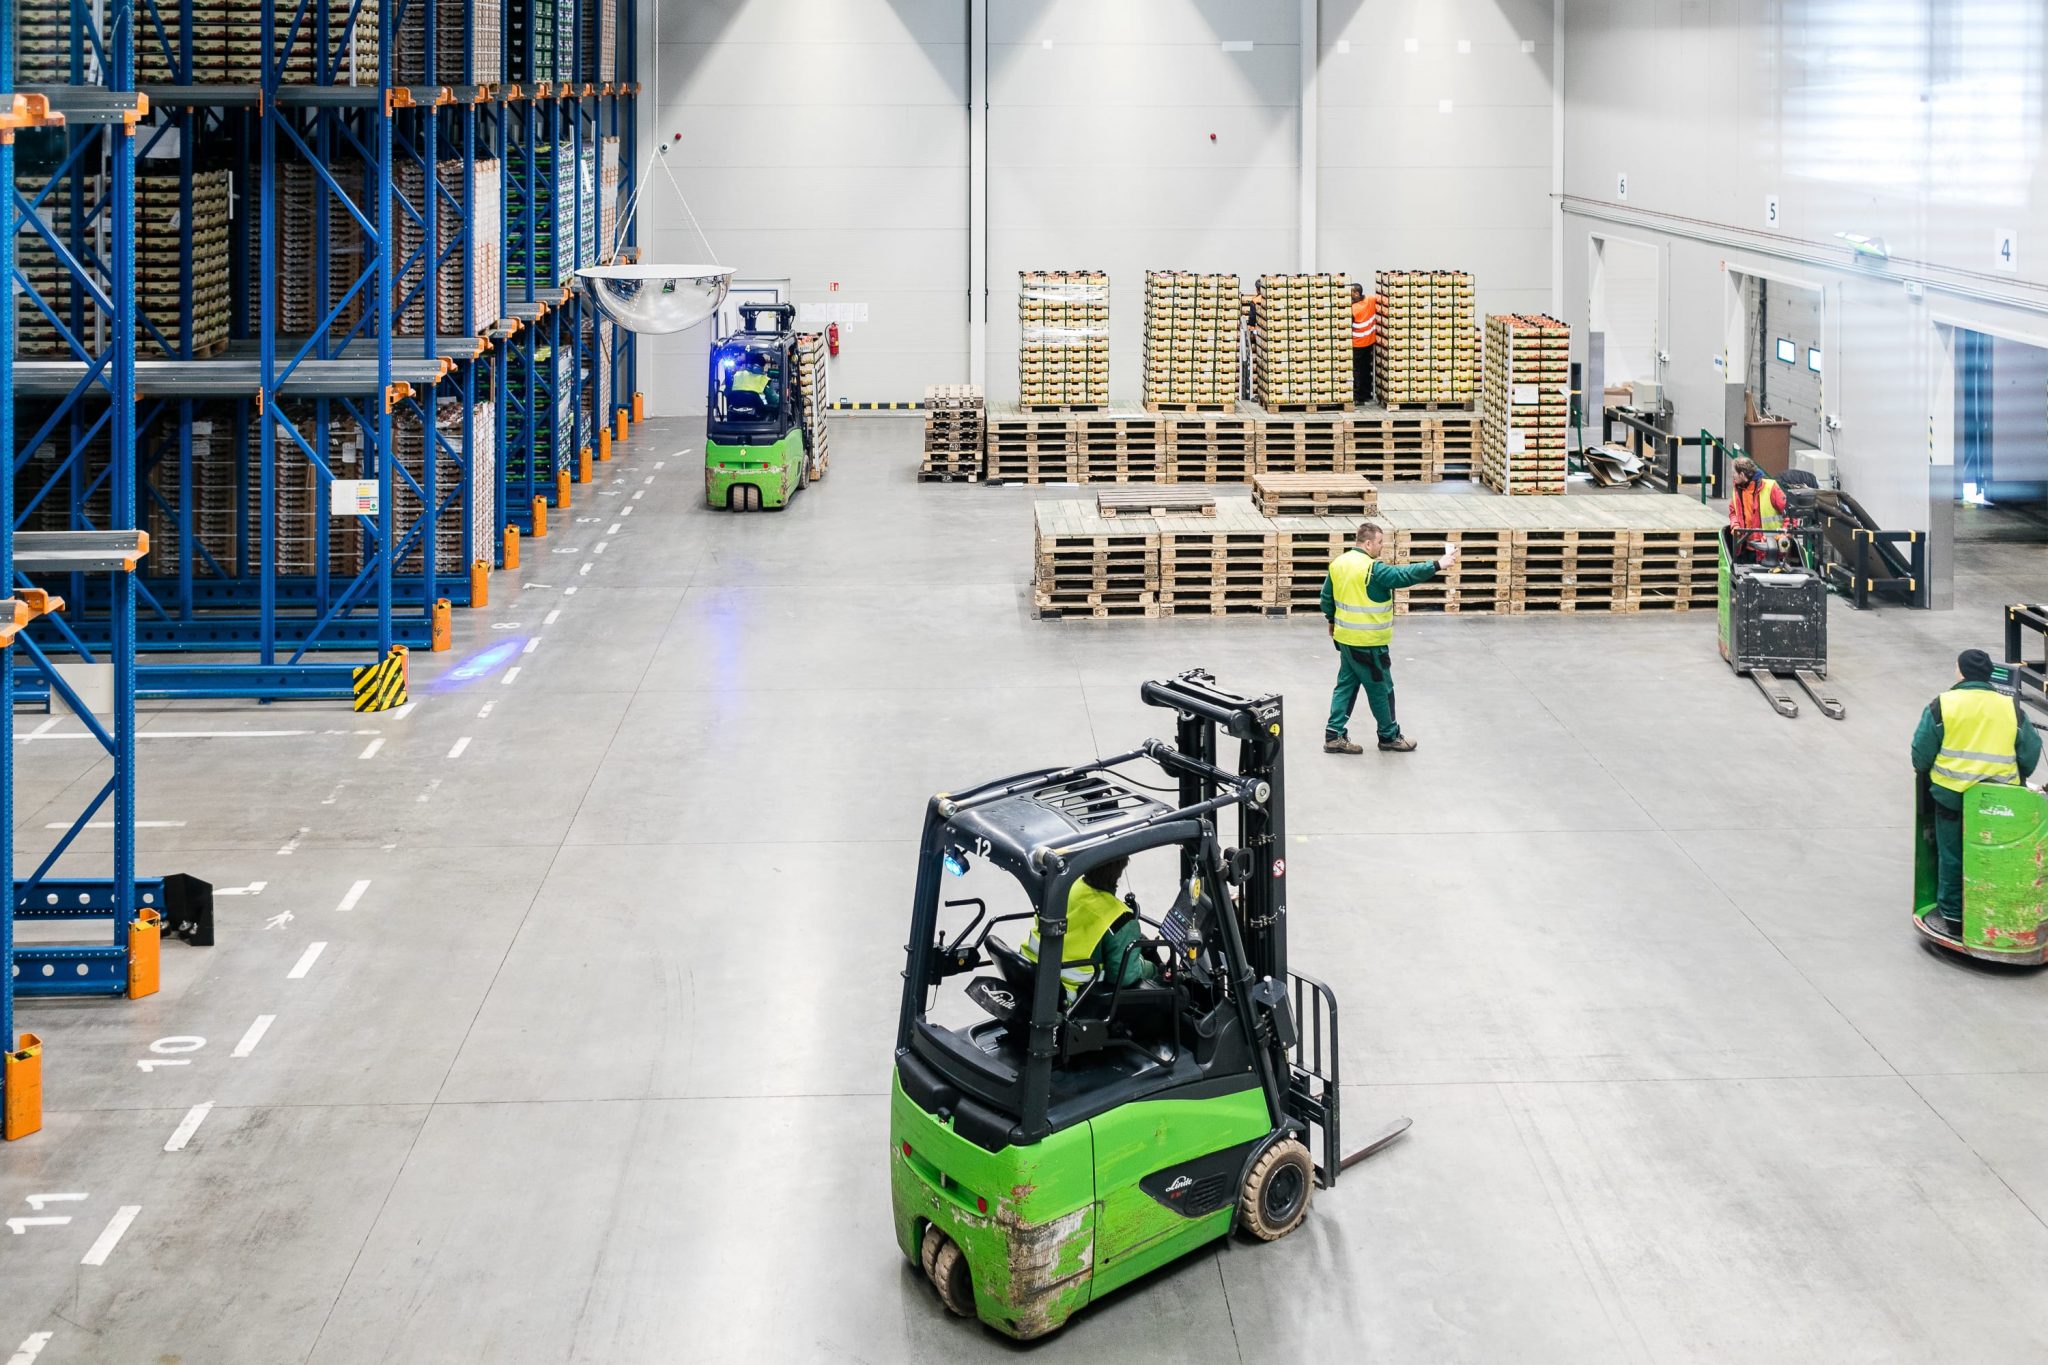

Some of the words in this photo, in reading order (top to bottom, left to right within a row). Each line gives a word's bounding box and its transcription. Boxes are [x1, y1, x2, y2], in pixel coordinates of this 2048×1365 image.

[1620, 179, 1625, 194] 6
[1770, 202, 1776, 221] 5
[2001, 238, 2011, 262] 4
[745, 344, 751, 352] 4
[974, 837, 992, 861] 12
[136, 1035, 207, 1072] 10
[1165, 1175, 1193, 1192] Linde
[5, 1192, 90, 1235] 11
